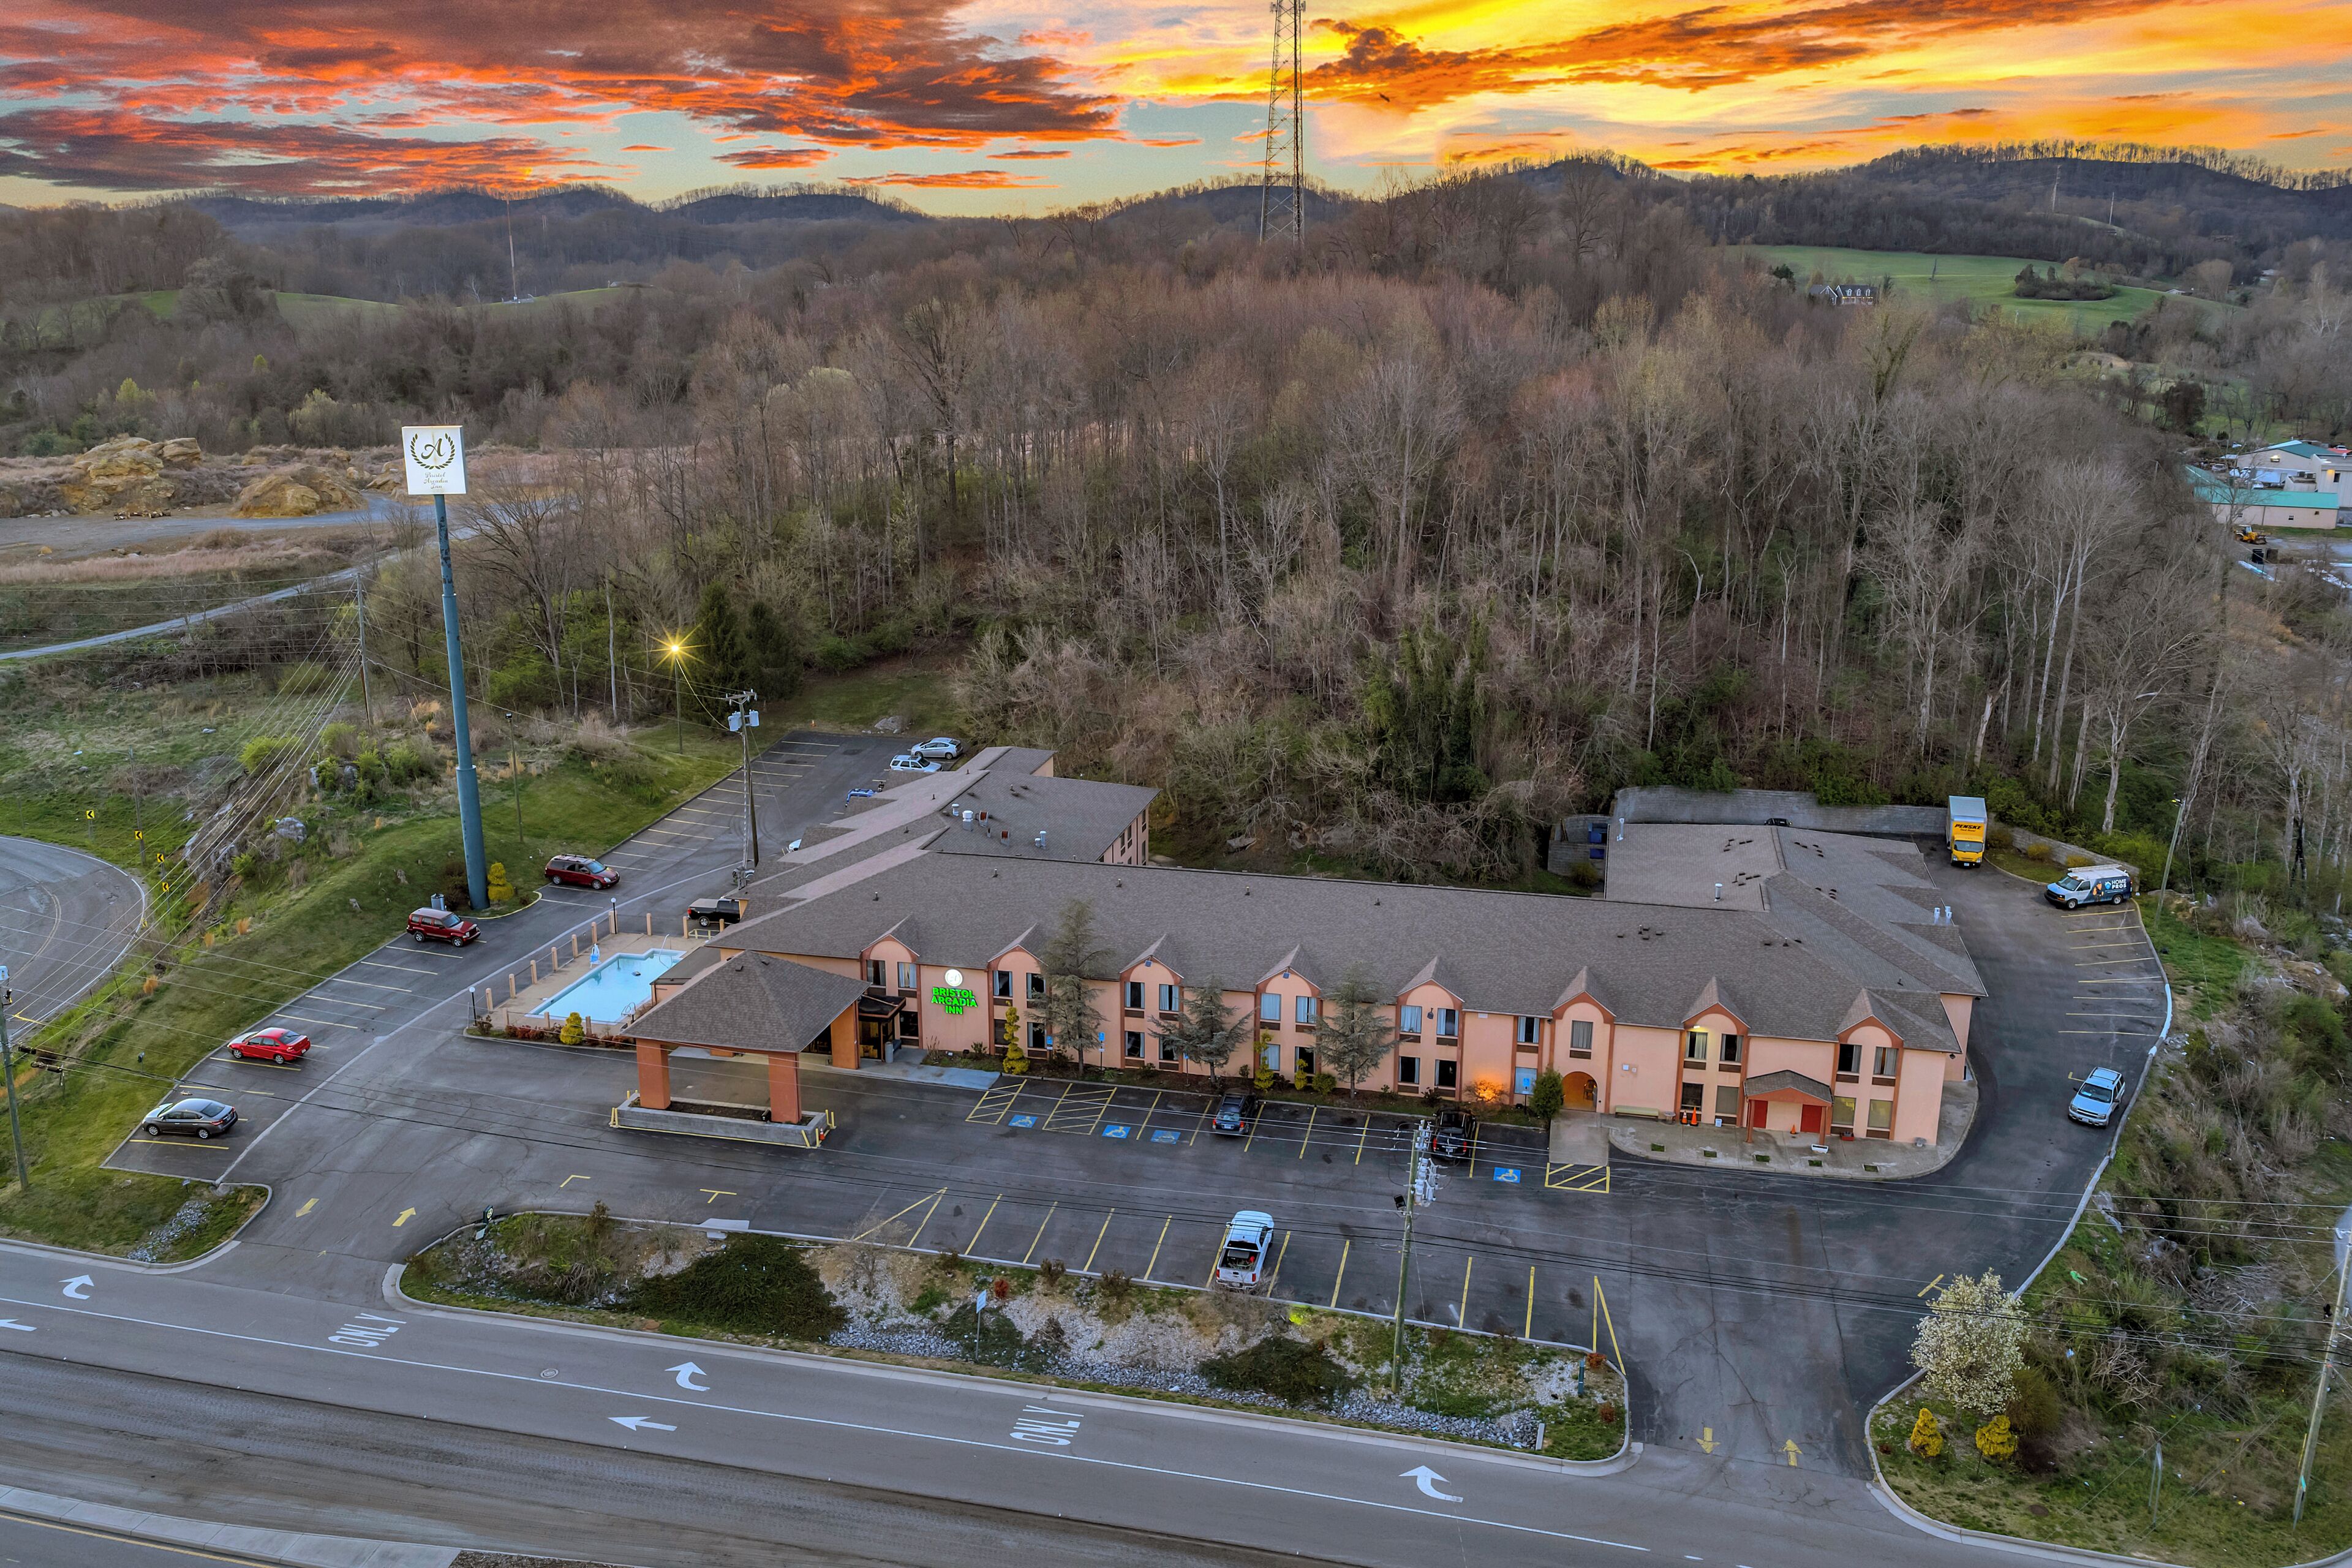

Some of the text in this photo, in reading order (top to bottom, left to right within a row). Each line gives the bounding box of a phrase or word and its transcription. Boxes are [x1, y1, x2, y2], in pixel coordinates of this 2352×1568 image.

[421, 438, 446, 459] A
[932, 987, 975, 998] BRISTOL
[932, 995, 978, 1007] ARCADIA
[945, 1005, 963, 1015] INN
[328, 1313, 407, 1347] ONLY
[1009, 1404, 1084, 1446] ONLY
